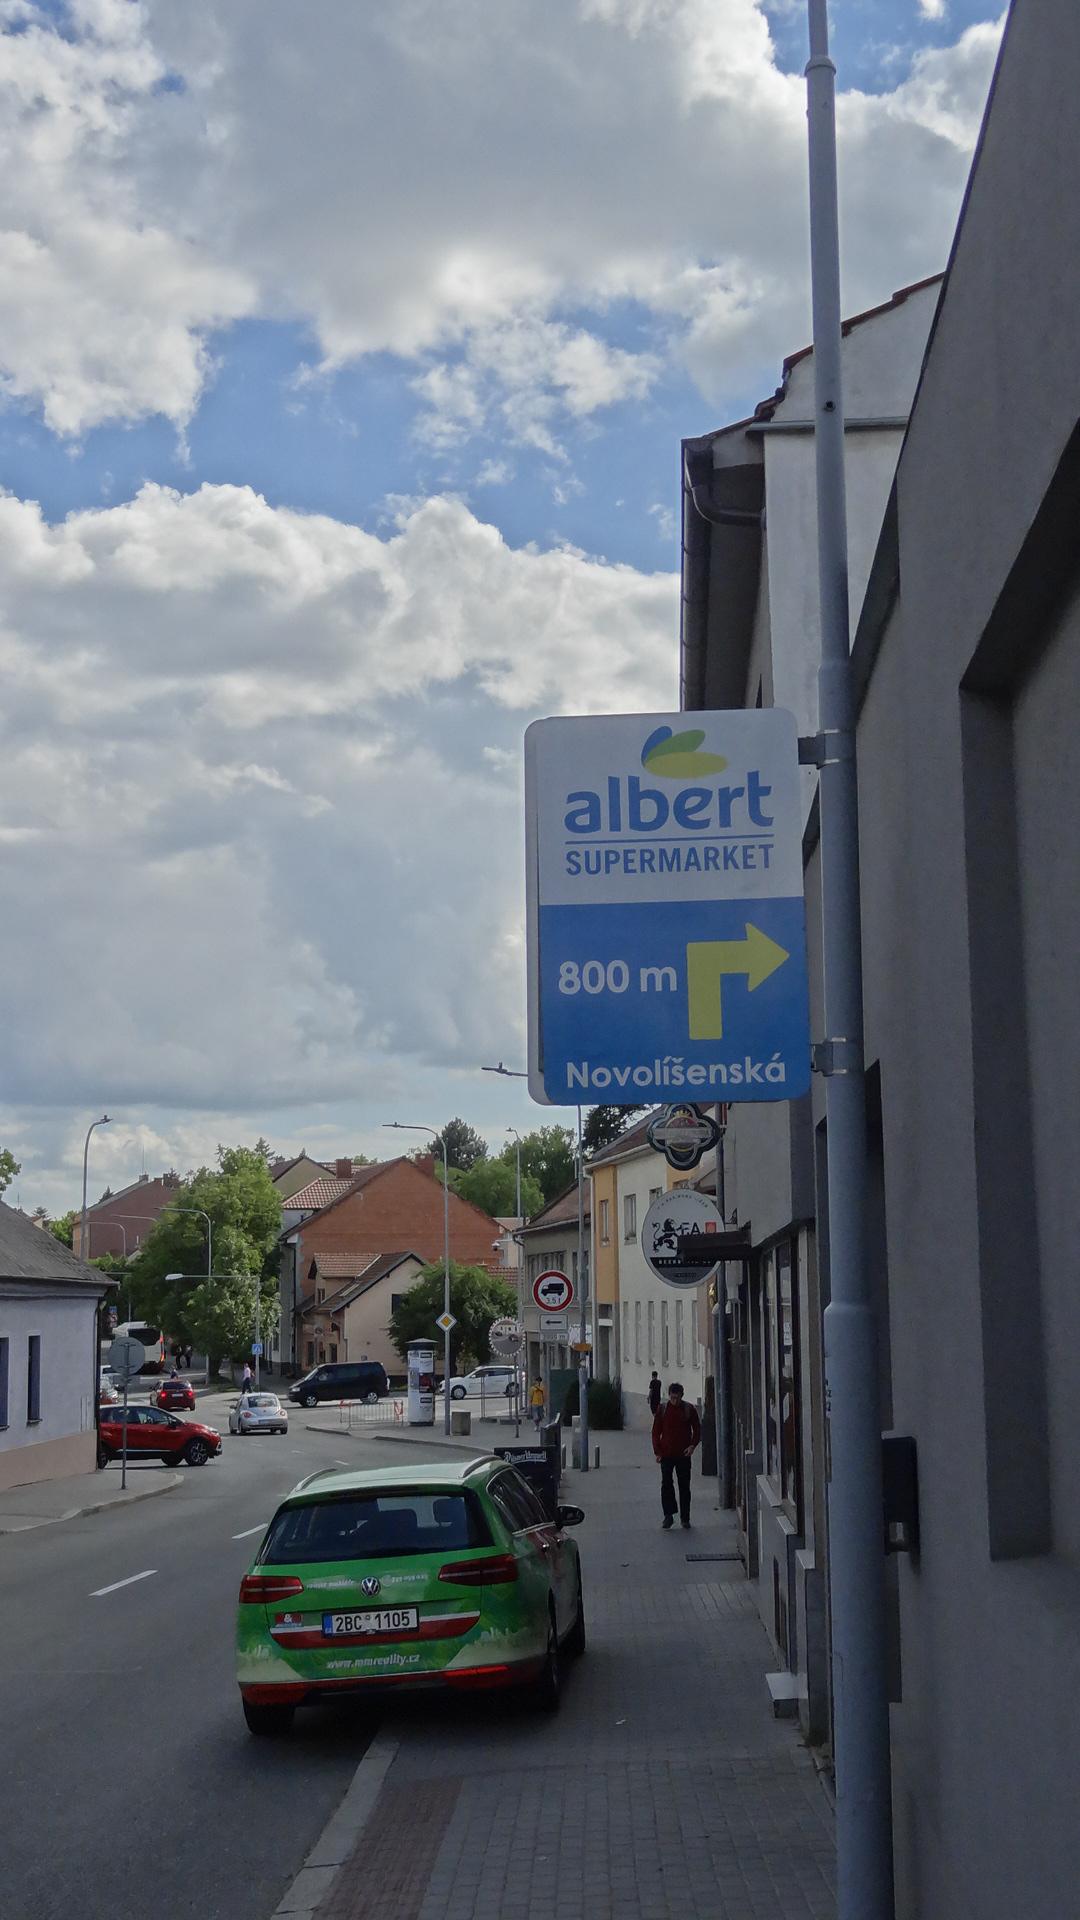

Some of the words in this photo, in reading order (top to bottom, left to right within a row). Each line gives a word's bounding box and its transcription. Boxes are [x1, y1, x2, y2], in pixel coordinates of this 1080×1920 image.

[564, 771, 774, 834] albert
[565, 844, 774, 876] SUPERMARKET
[558, 959, 630, 995] 800
[639, 965, 678, 992] m
[566, 1052, 787, 1089] Novolíšenská
[335, 1615, 362, 1632] 2BC
[374, 1611, 410, 1629] 1105
